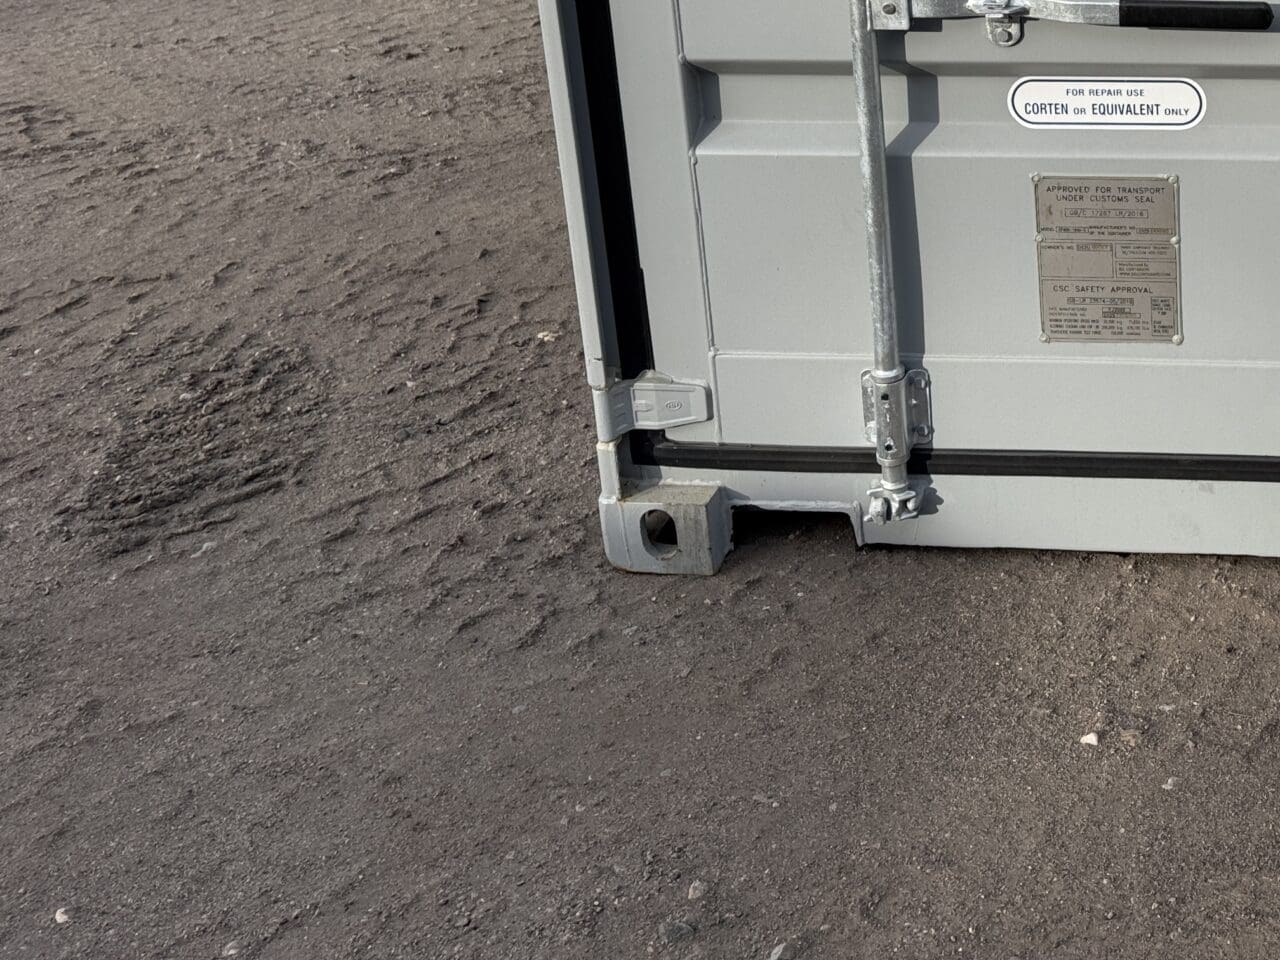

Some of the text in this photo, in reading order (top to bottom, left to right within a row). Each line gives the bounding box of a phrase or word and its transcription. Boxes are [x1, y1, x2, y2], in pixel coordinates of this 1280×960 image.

[1066, 88, 1145, 97] FOR REPAIR USE
[1024, 102, 1069, 115] CORTEN
[1092, 103, 1161, 116] EQUIVALENT
[1164, 107, 1190, 116] ONLY
[1046, 185, 1166, 195] APPROVED FOR TRANSPORT
[1056, 194, 1155, 203] UNDER CUSTOMS SEAL
[1053, 285, 1154, 294] CSC SAFETY APPROVAL
